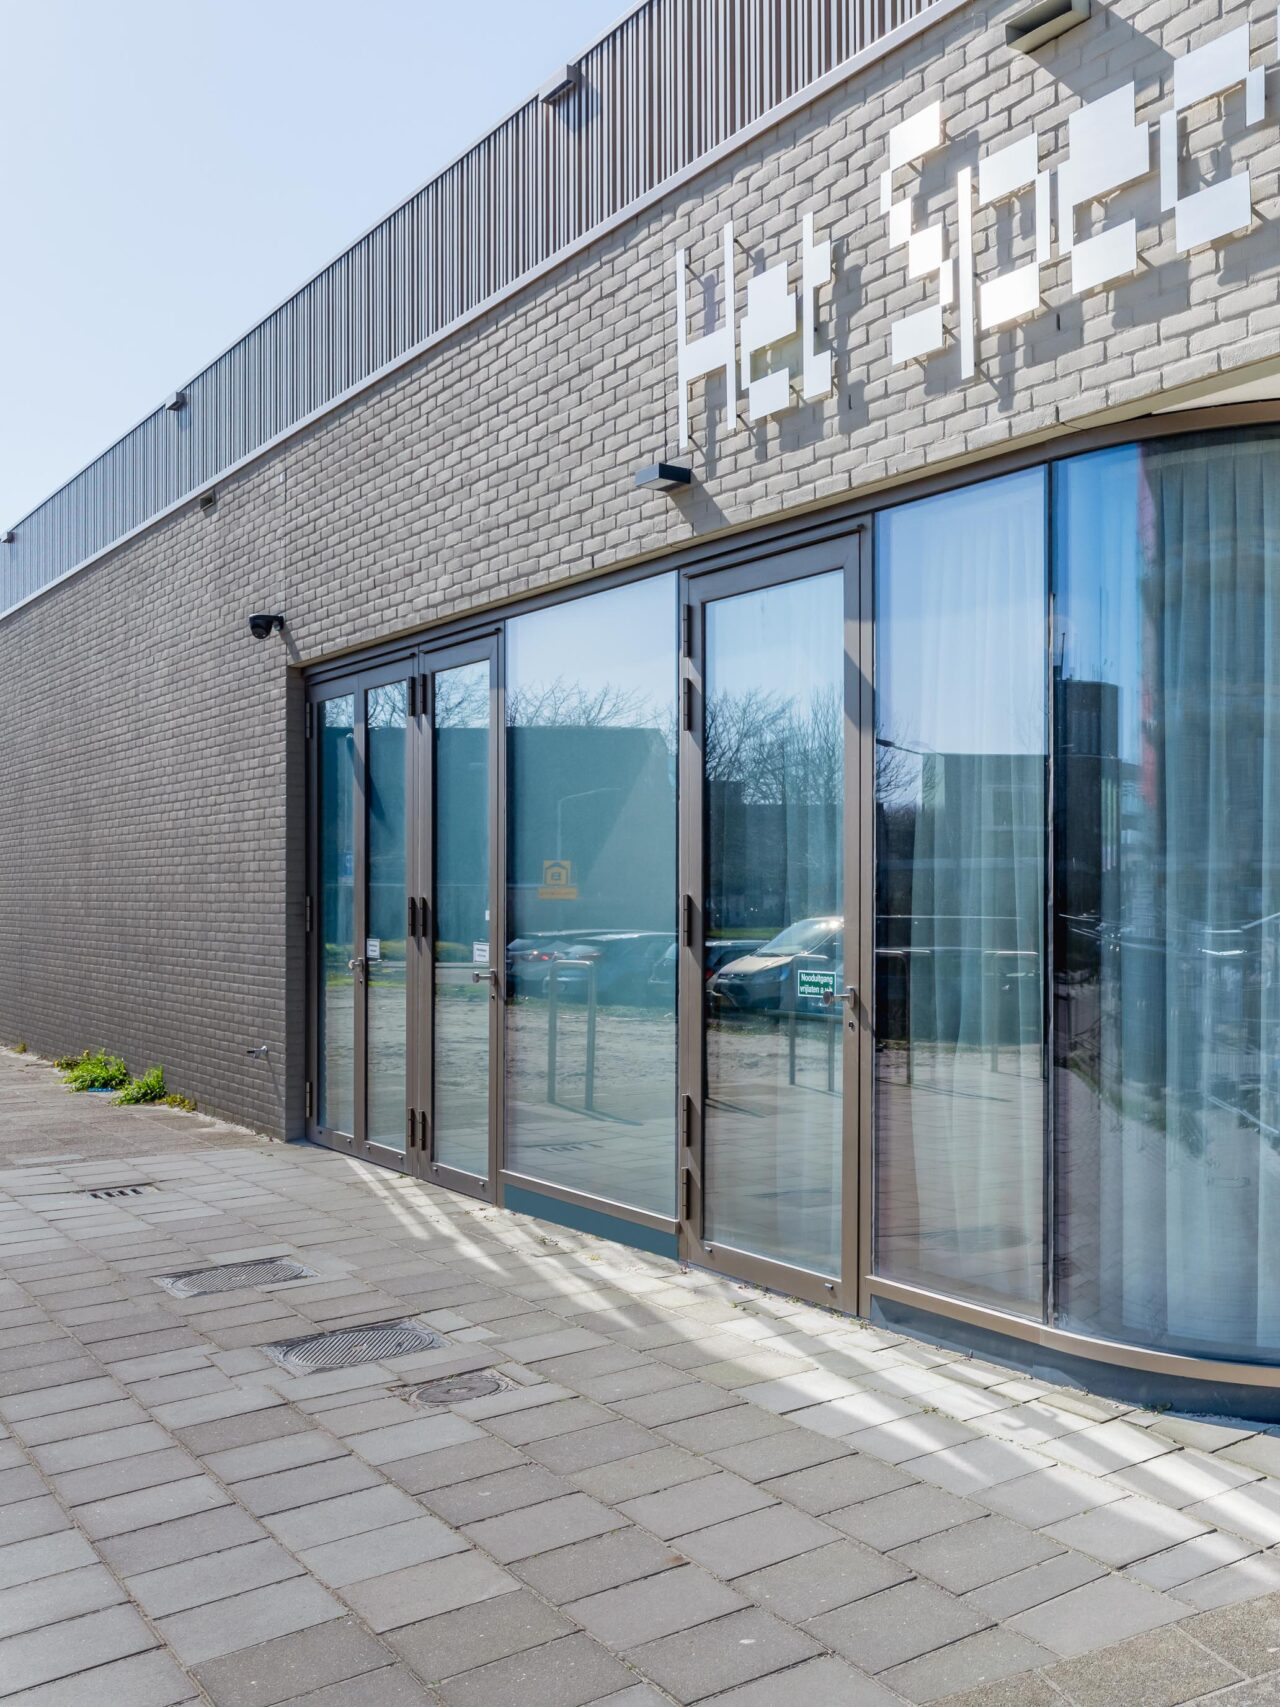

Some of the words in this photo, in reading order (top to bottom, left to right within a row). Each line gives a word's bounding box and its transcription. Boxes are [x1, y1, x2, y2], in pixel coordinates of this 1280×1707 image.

[676, 211, 832, 449] Het
[801, 973, 833, 984] Nooduitgang
[800, 985, 819, 993] vrijlaten
